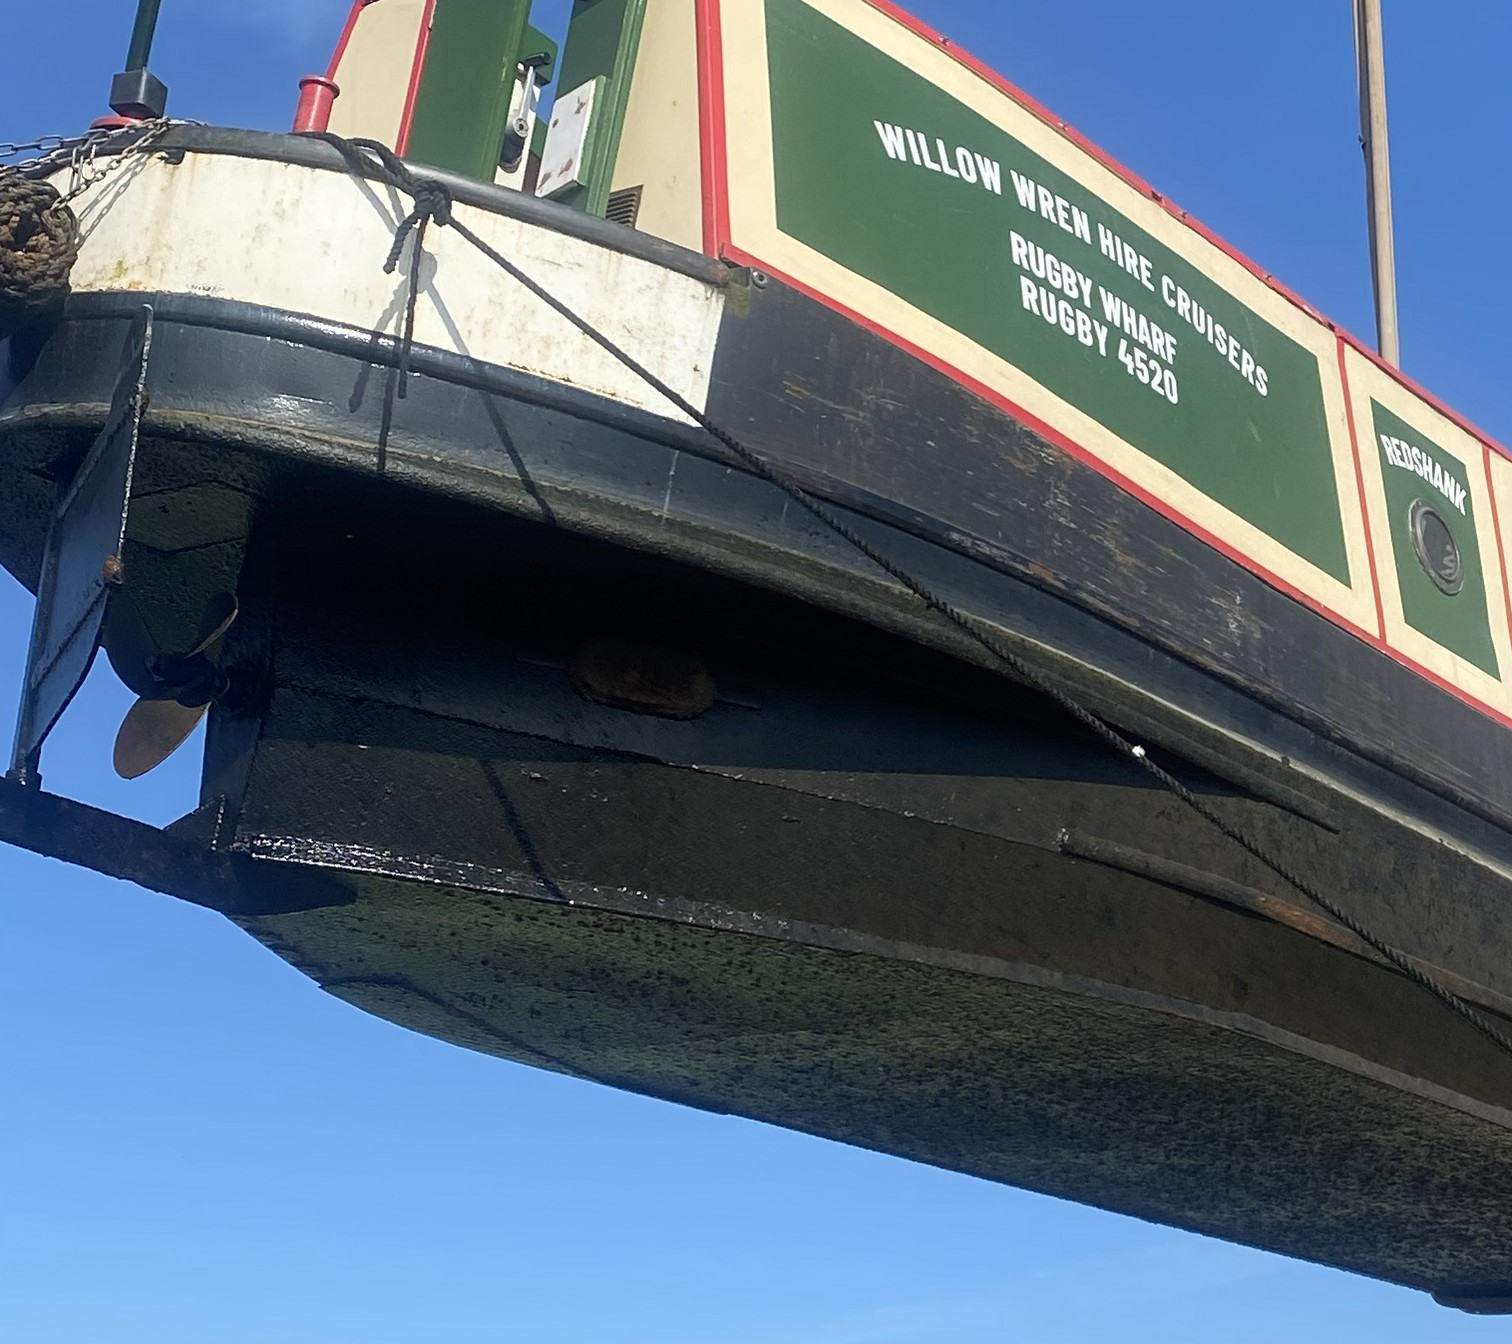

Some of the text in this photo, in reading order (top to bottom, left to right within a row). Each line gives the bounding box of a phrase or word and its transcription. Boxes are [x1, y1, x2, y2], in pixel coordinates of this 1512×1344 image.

[873, 119, 1268, 397] WILLOW WREN HIRE CRUISERS
[1009, 230, 1178, 366] RUGBY WHARF
[1019, 274, 1179, 405] RUGBY 4520
[1379, 433, 1467, 517] REDSHANK
